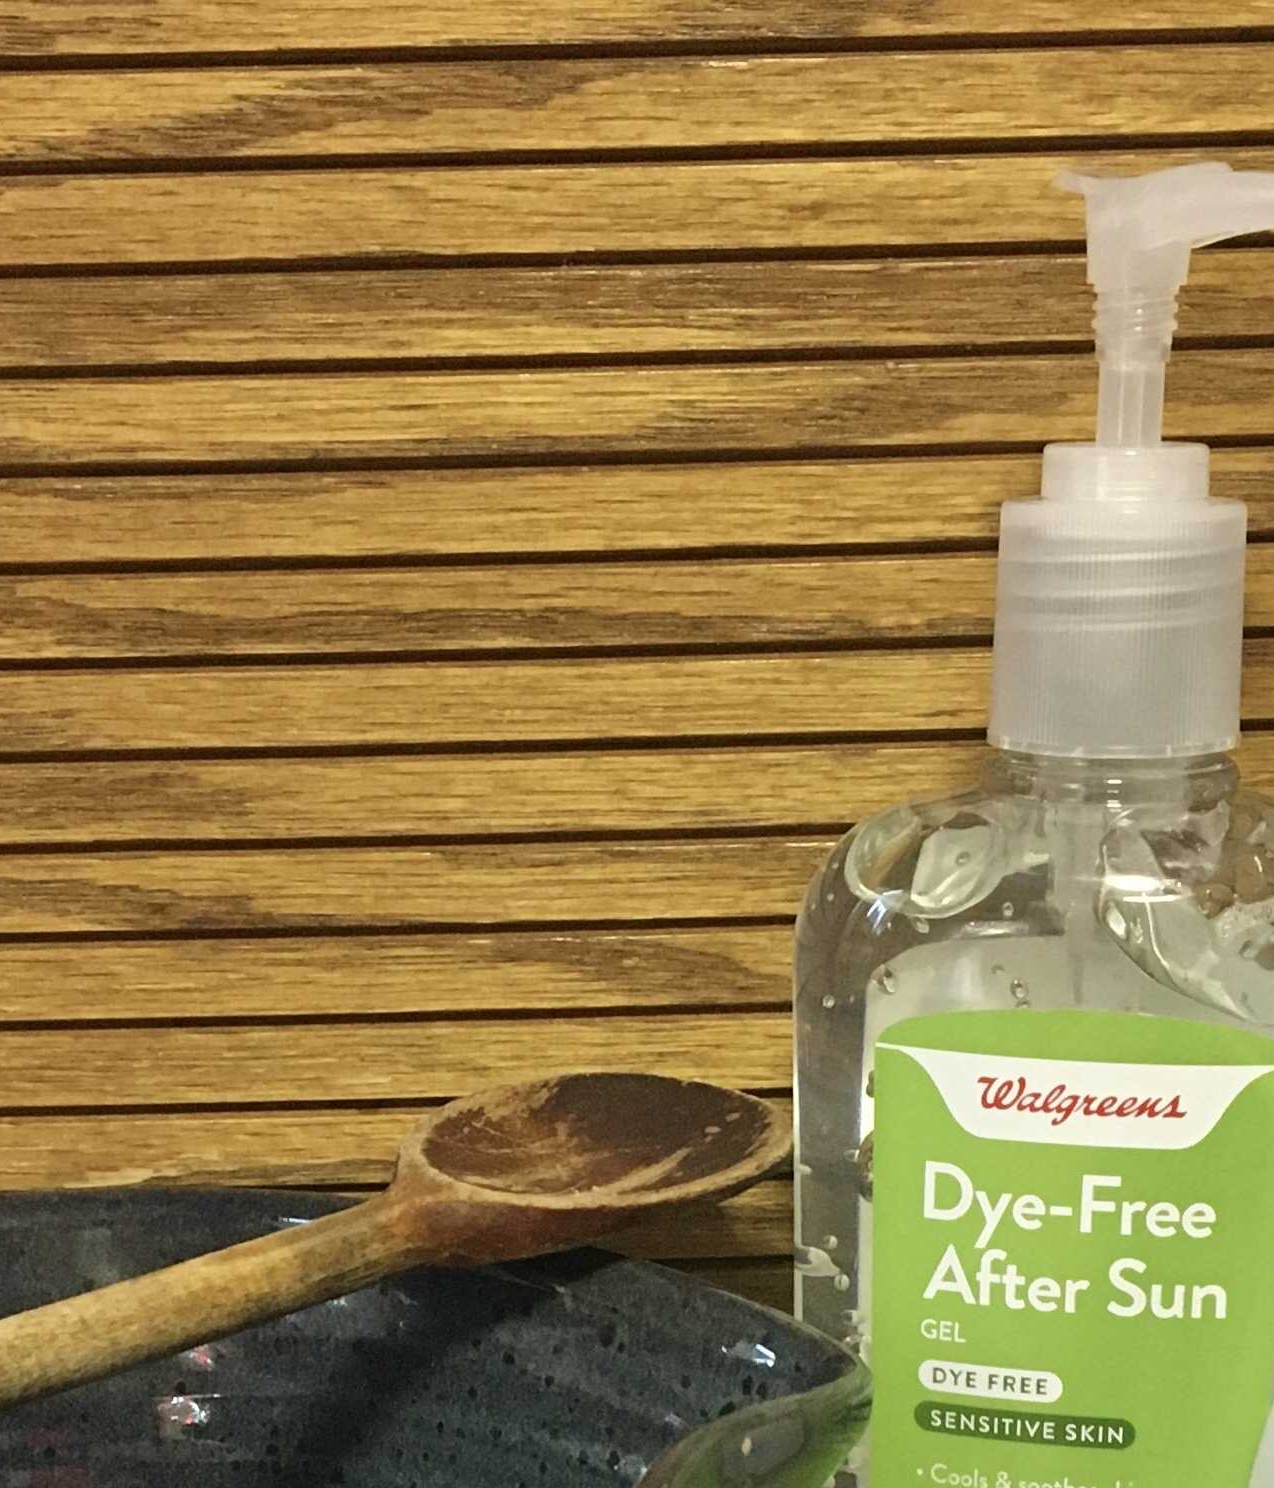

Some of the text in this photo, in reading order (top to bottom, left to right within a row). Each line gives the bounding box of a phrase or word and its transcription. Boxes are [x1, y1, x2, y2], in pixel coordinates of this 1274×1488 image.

[976, 1075, 1187, 1125] Walgreens
[924, 1161, 1216, 1248] Dye-Free
[923, 1244, 1227, 1319] After Sun
[920, 1318, 966, 1344] GEL
[932, 1366, 1048, 1396] DYE FREE
[930, 1409, 1124, 1444] SENSITIVE SKIN
